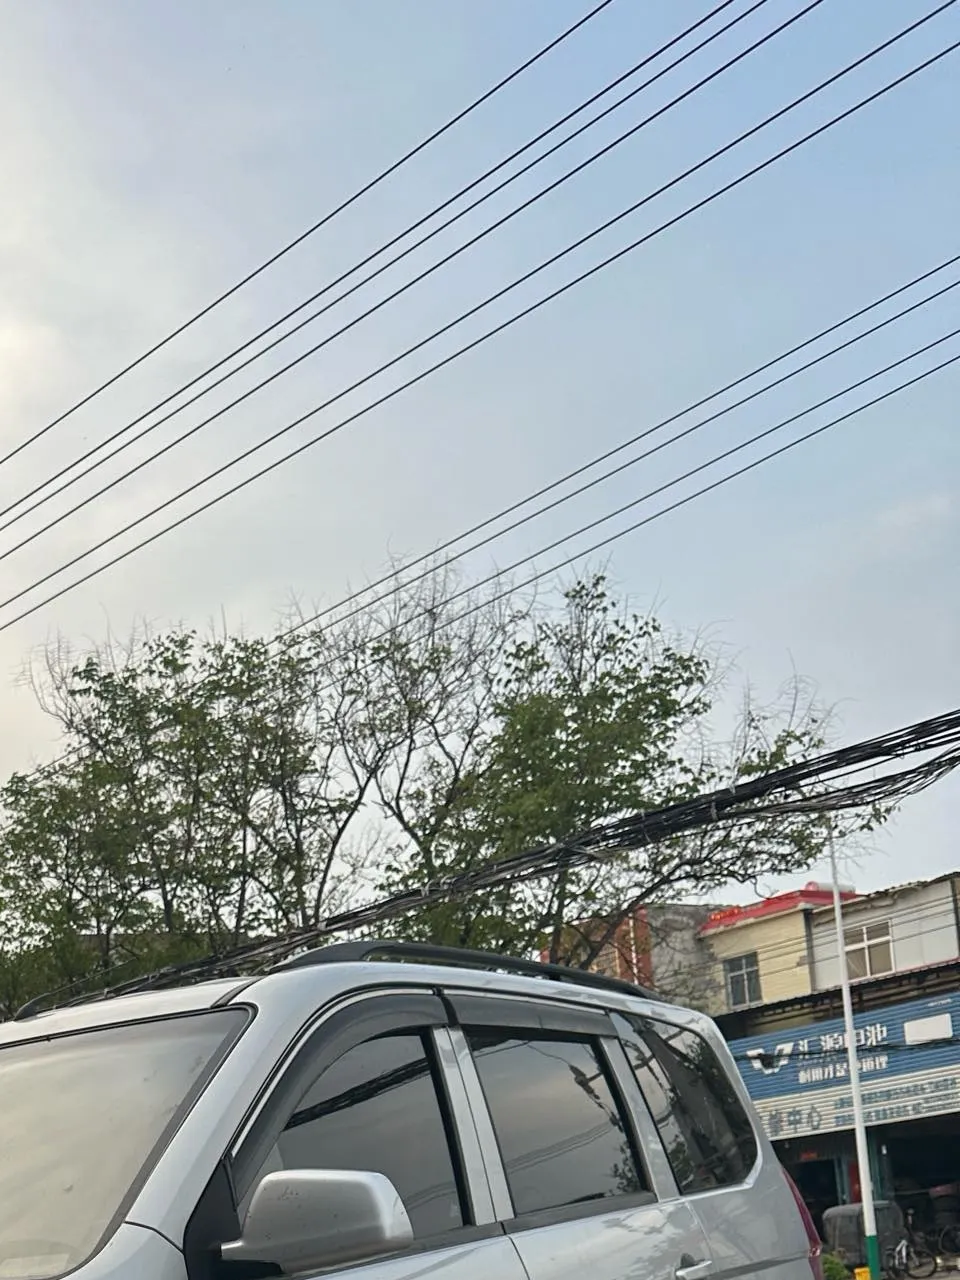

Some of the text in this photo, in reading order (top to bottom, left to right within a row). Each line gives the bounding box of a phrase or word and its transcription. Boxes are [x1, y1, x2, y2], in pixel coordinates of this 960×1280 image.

[799, 1055, 888, 1083] 耐用才是道理
